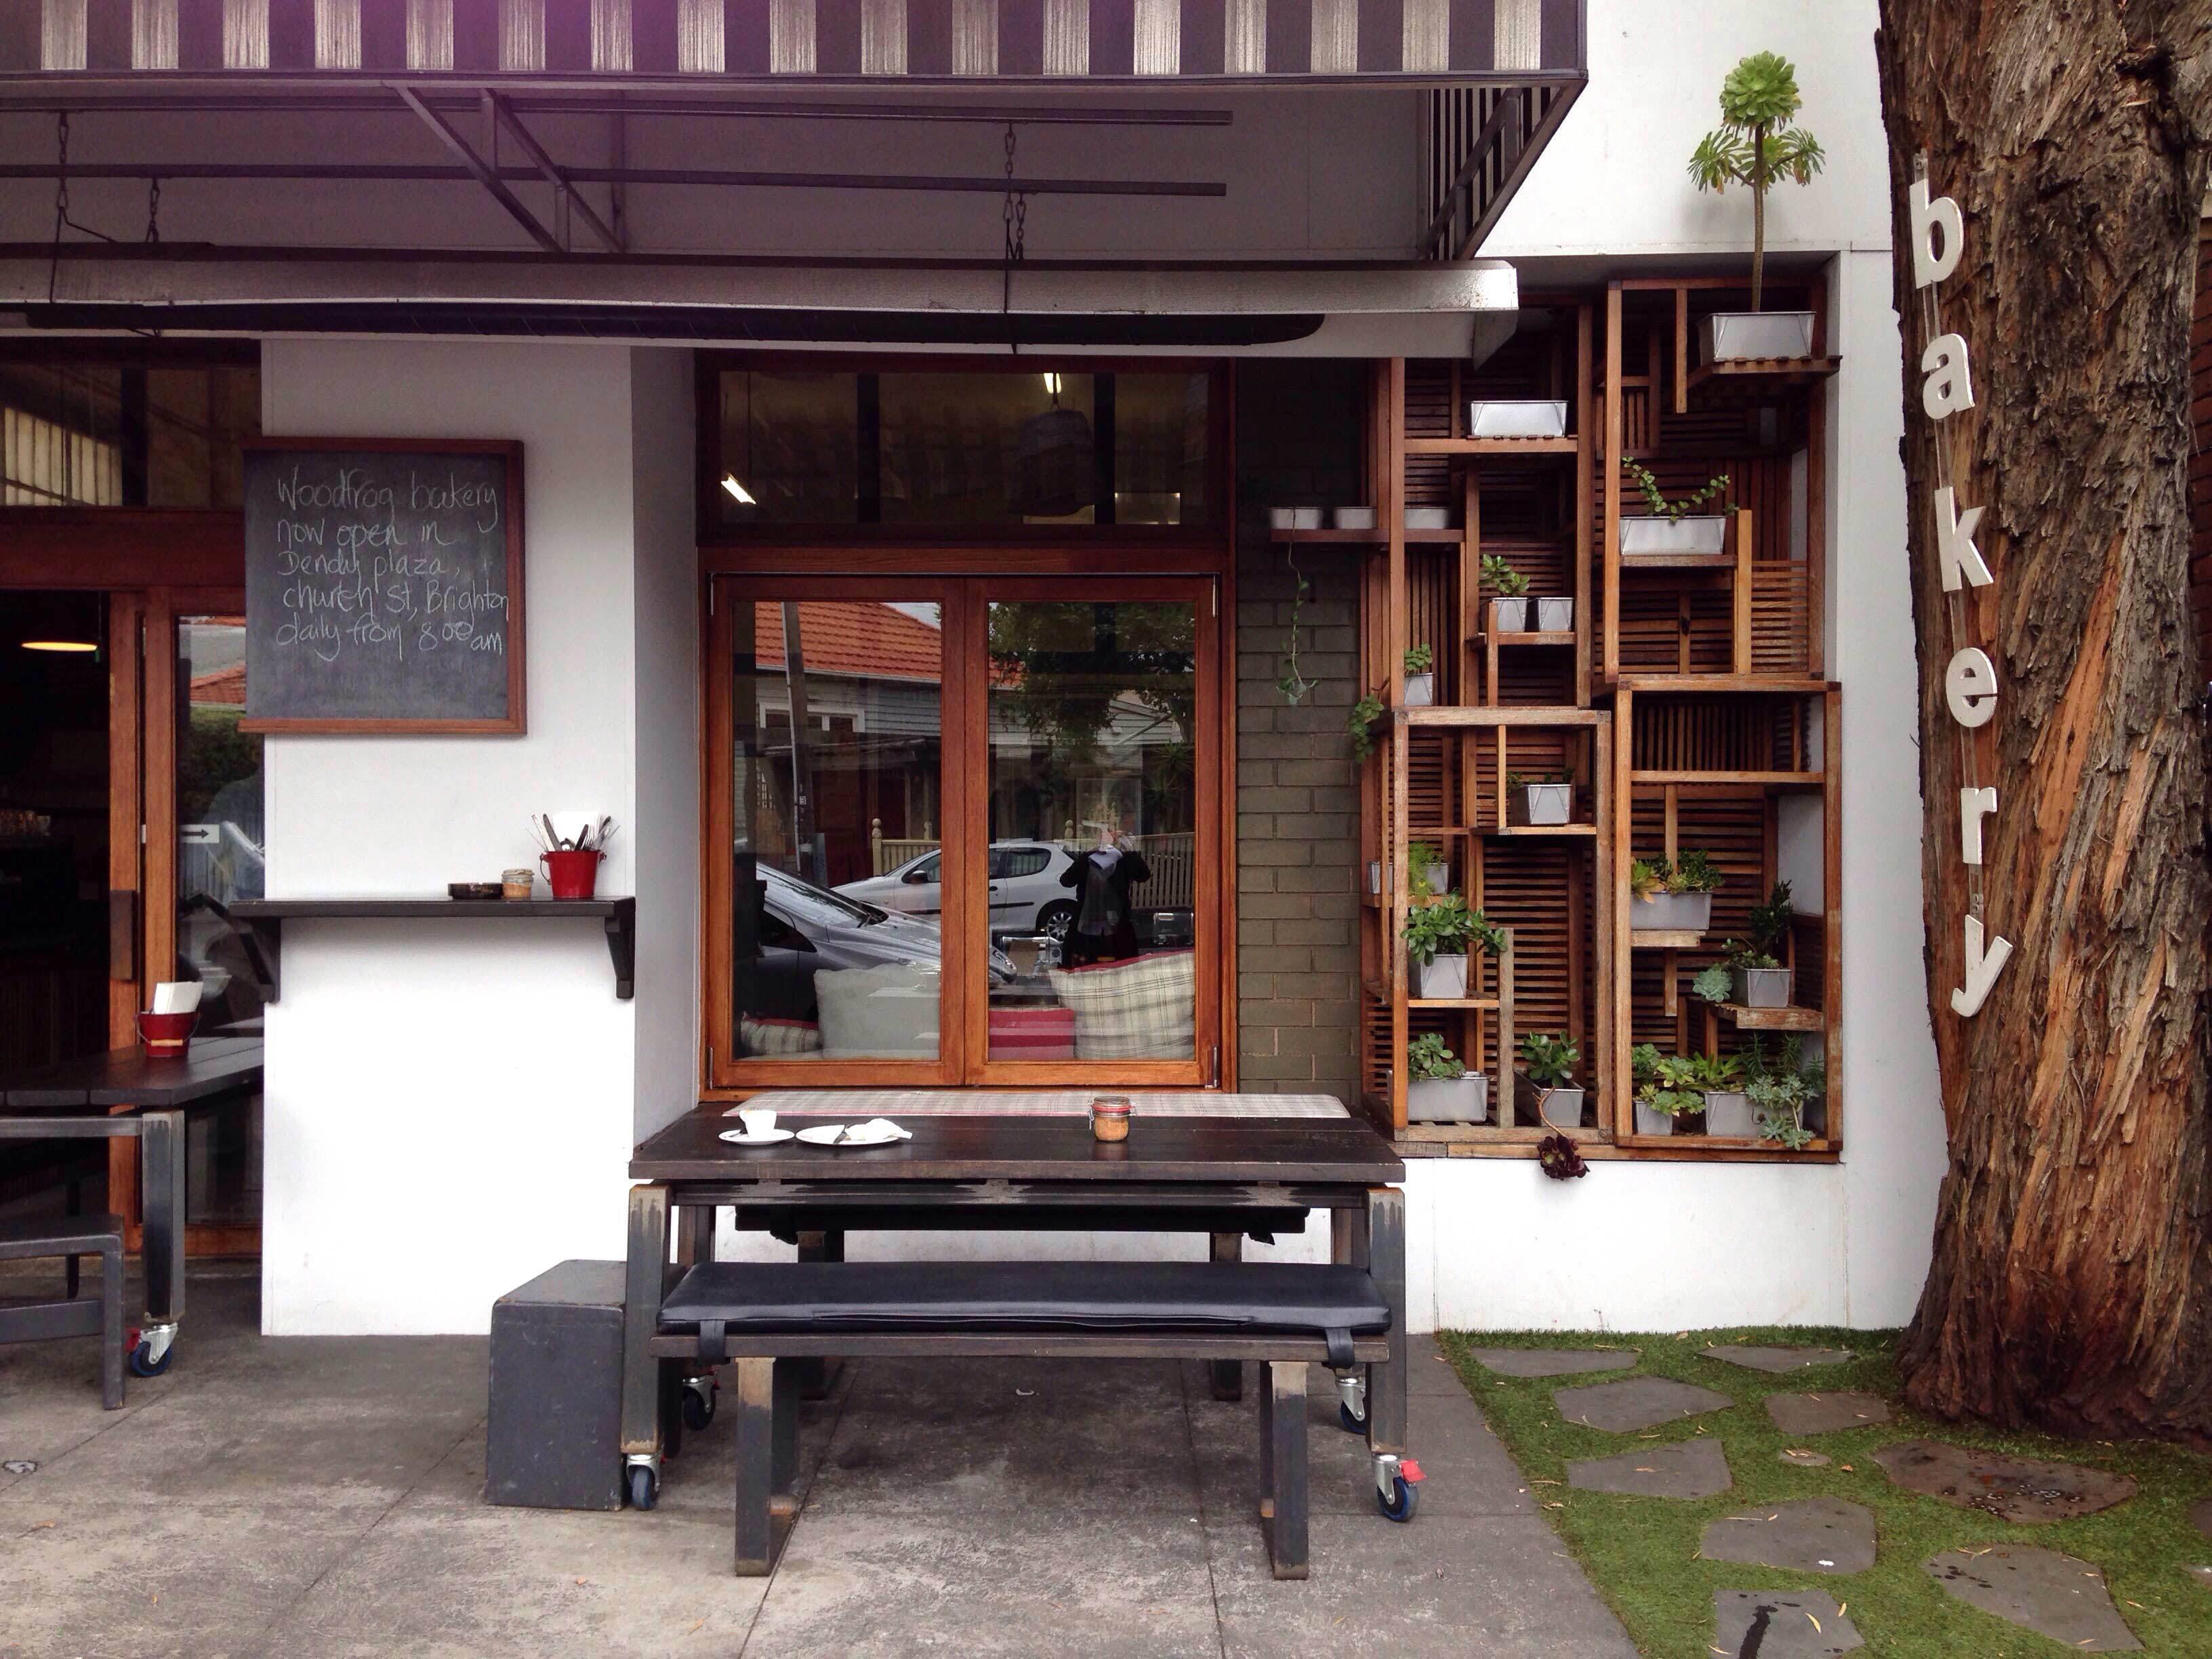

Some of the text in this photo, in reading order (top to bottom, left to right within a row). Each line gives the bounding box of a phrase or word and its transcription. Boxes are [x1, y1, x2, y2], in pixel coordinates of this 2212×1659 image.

[277, 464, 498, 533] Woodfrog bakery
[278, 518, 455, 556] now open in
[278, 548, 362, 588] Dendy
[426, 579, 509, 627] Brighton
[1909, 178, 2013, 1019] bakery
[276, 611, 340, 662] daily
[347, 613, 403, 661] from
